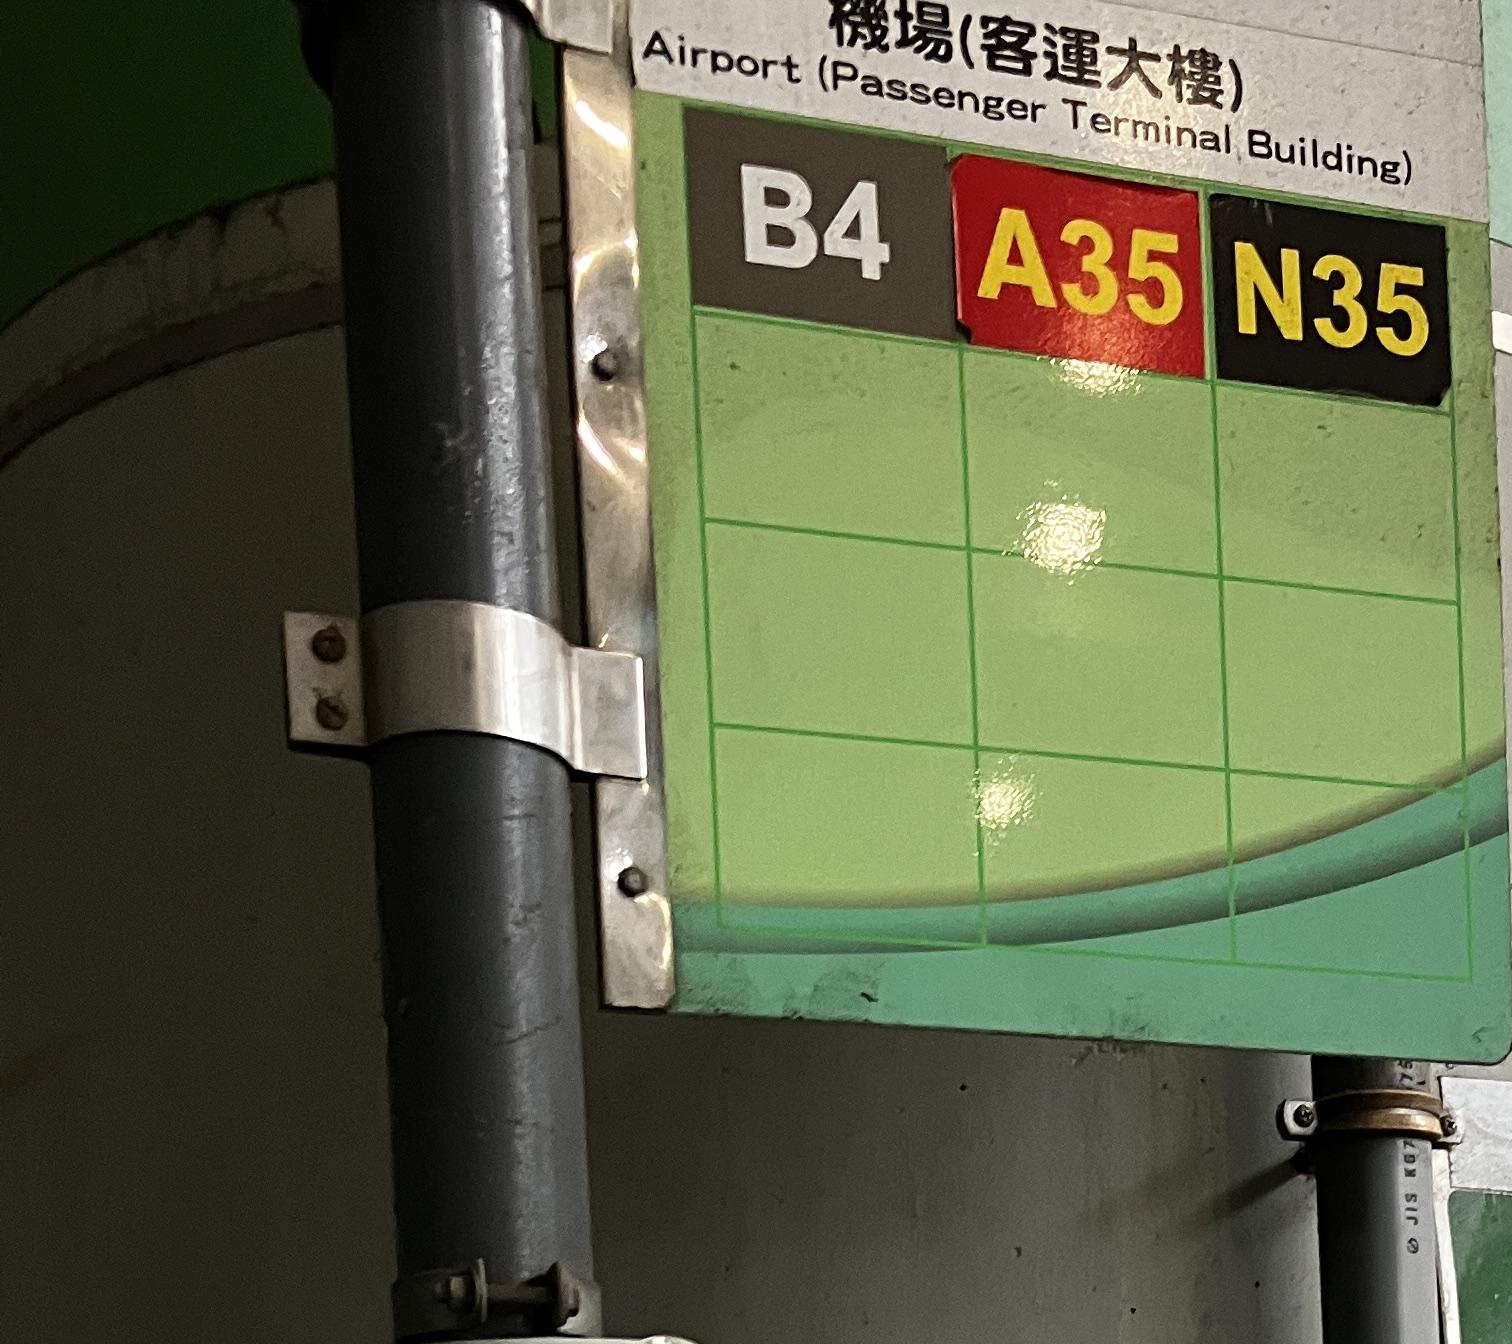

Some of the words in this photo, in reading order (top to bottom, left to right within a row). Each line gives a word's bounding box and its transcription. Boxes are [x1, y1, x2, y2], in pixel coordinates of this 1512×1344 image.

[643, 31, 801, 85] Airport
[819, 55, 1047, 122] (Passenger
[1062, 99, 1231, 154] Terminal
[1247, 130, 1413, 187] Building)
[740, 164, 890, 280] B4
[978, 207, 1183, 326] A35
[1234, 241, 1430, 357] N35
